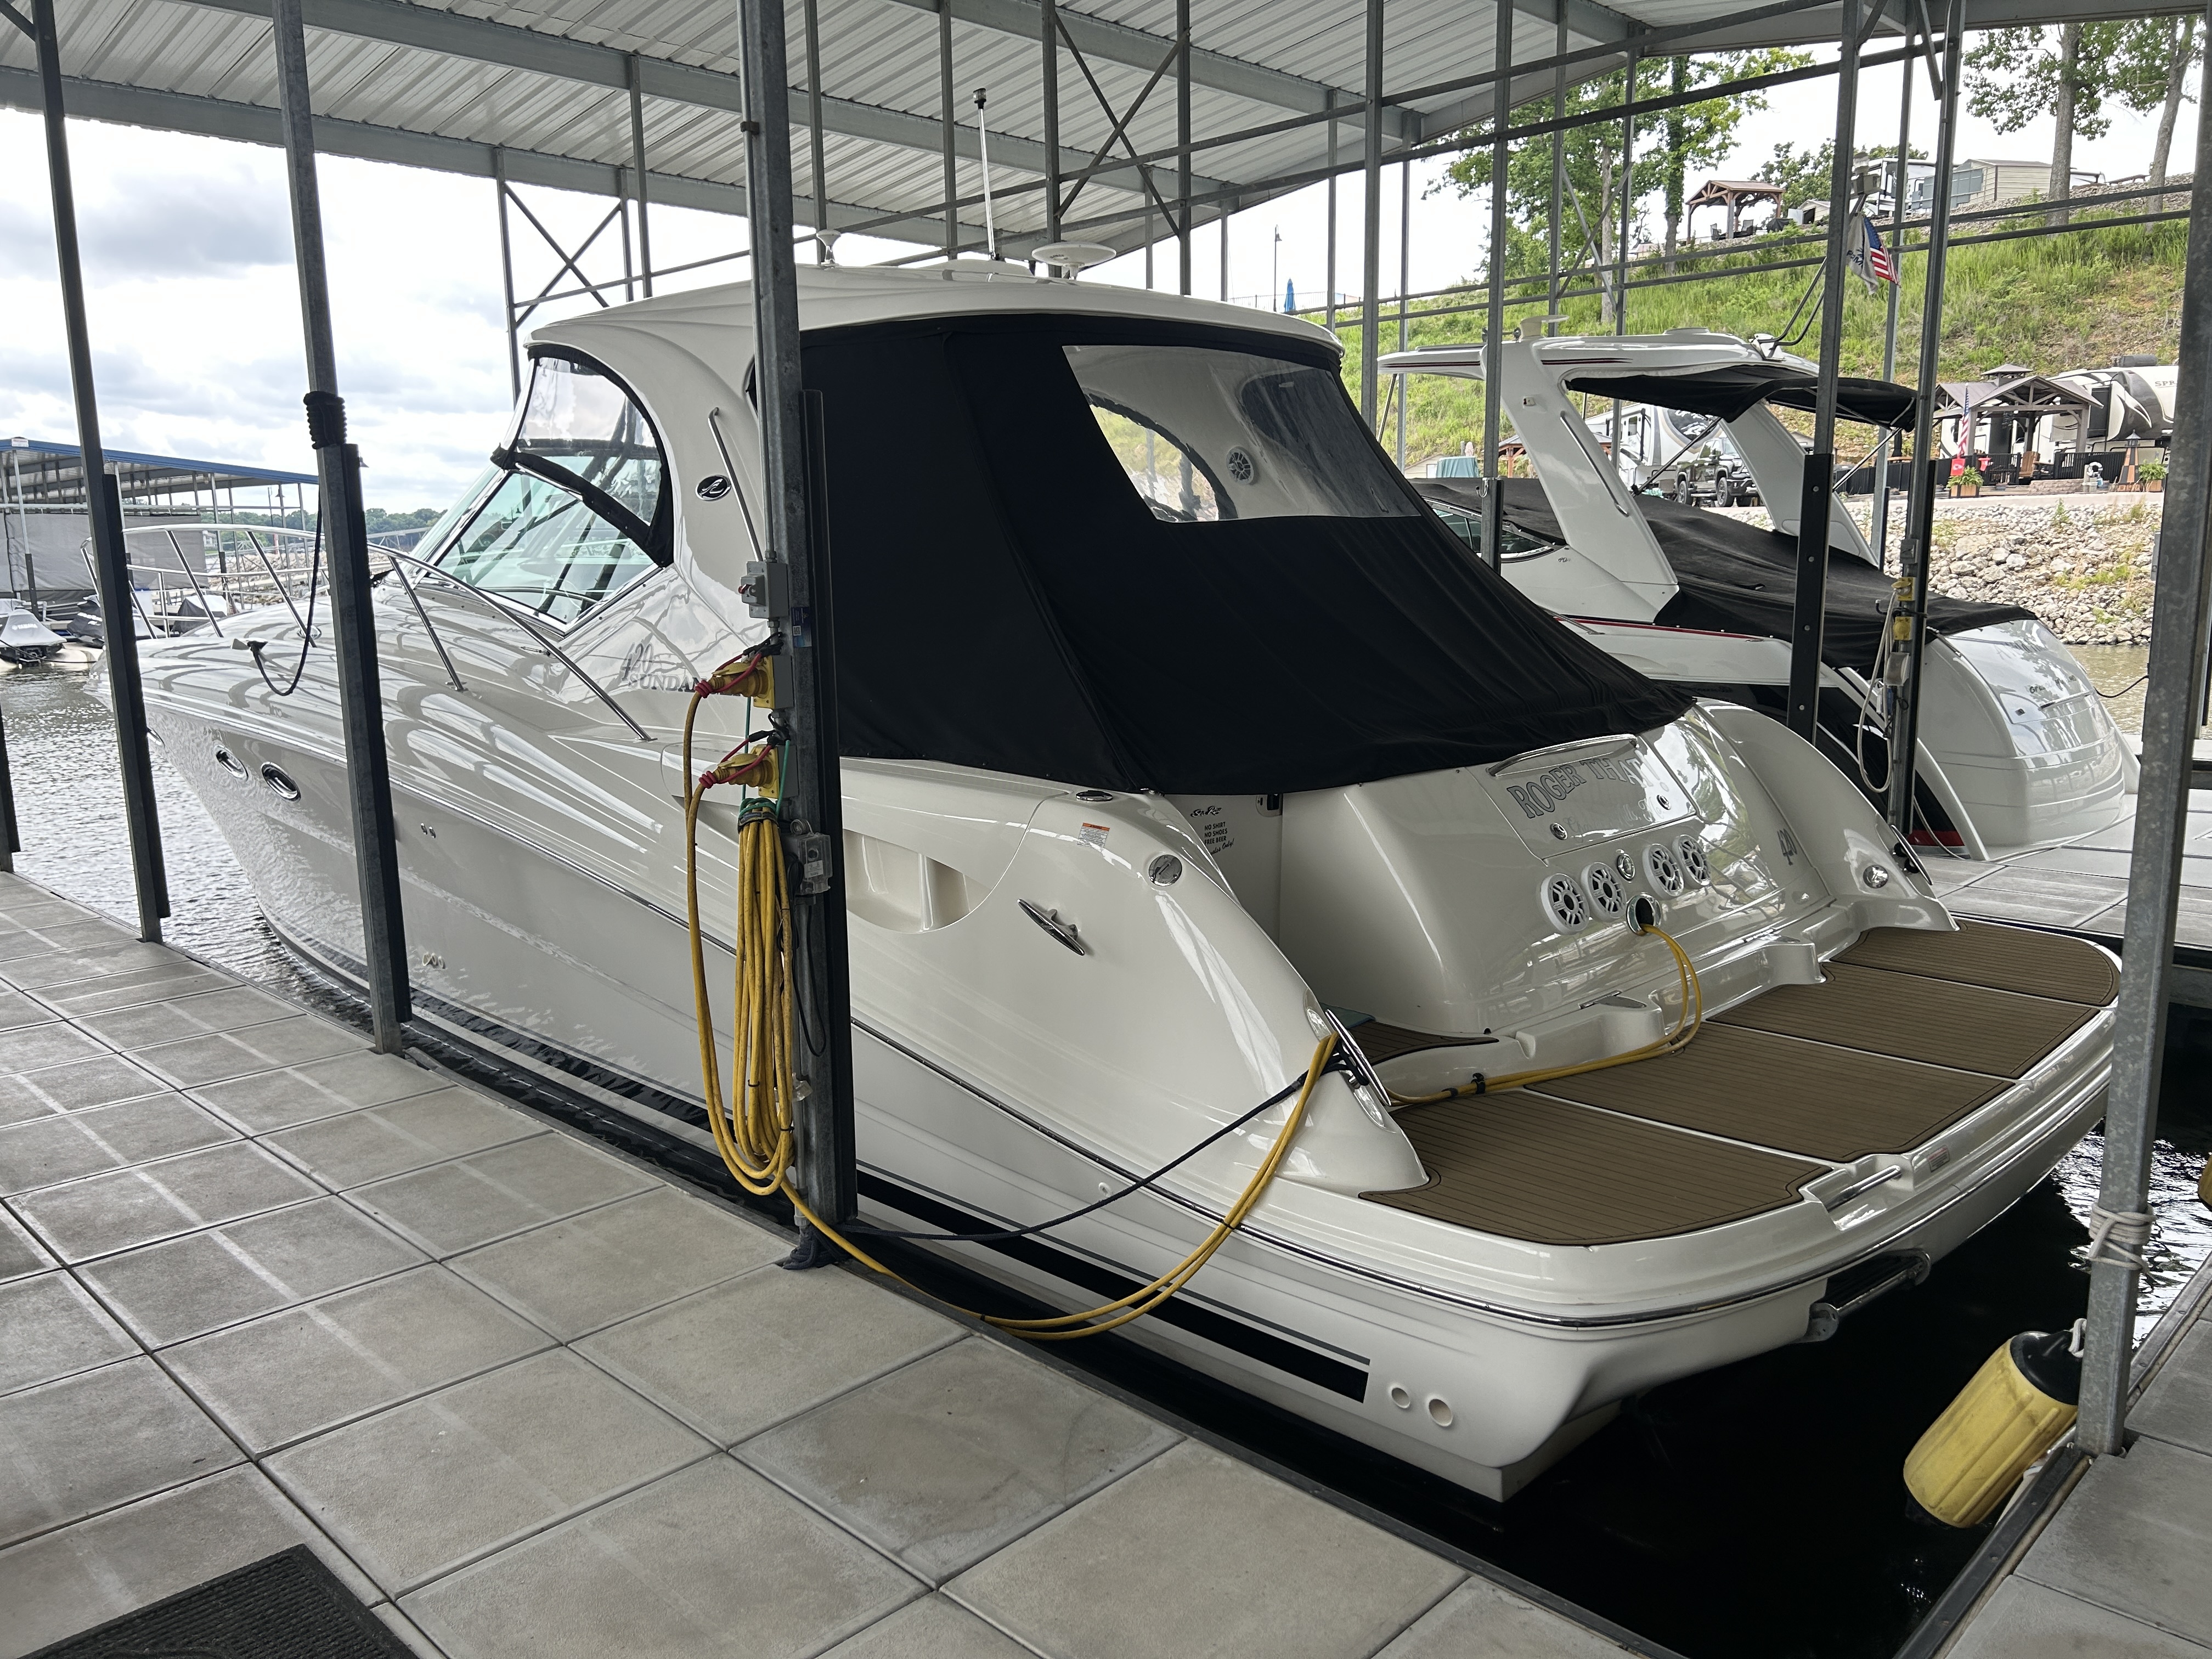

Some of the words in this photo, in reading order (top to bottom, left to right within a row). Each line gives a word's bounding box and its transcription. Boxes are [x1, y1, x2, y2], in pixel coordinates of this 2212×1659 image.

[620, 642, 654, 681] 420
[1506, 764, 1587, 819] ROGER
[1212, 828, 1228, 836] SHOES
